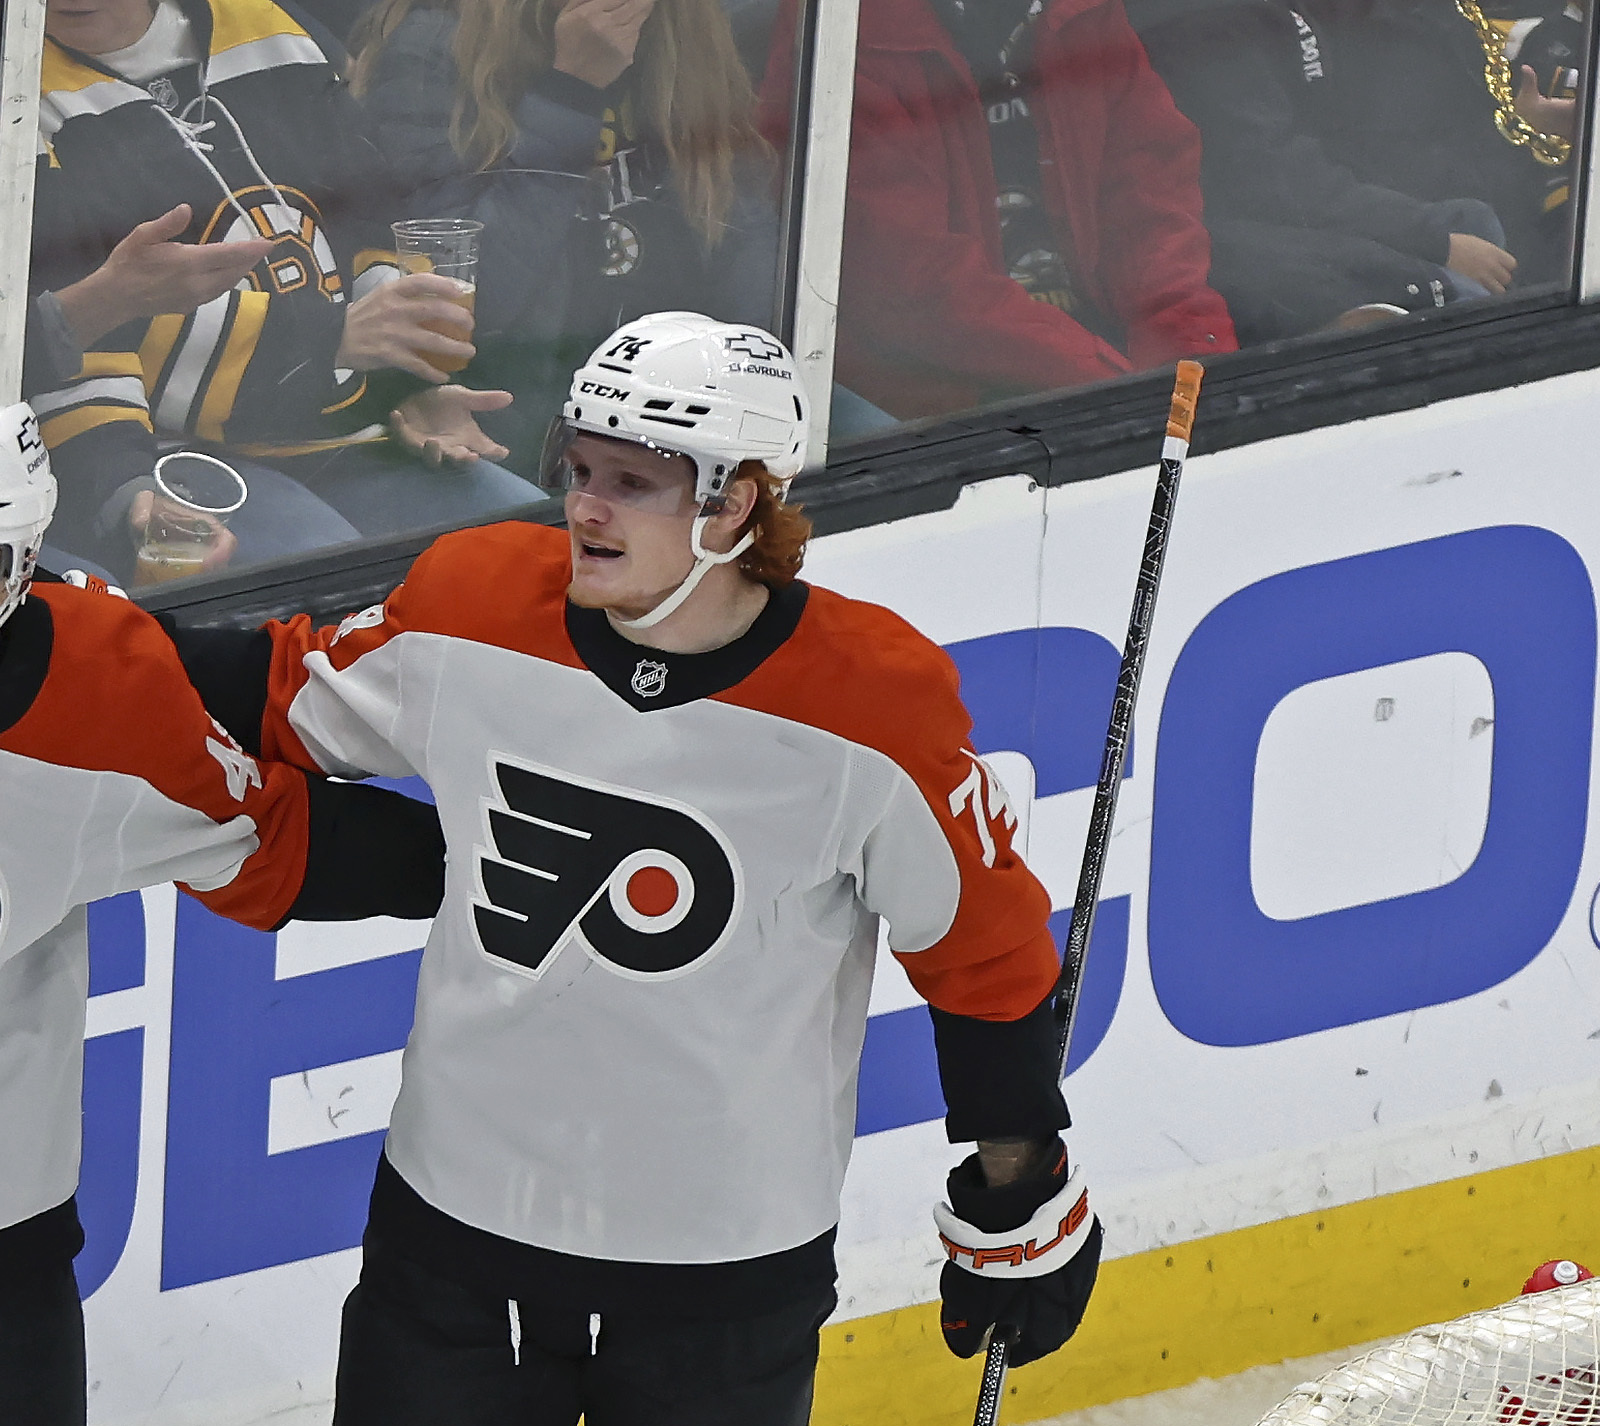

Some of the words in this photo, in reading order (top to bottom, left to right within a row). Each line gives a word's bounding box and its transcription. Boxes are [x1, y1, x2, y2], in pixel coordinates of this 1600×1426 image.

[605, 336, 652, 361] 74
[580, 381, 631, 402] CCM
[72, 524, 1599, 1310] ECO
[939, 1186, 1089, 1269] TRUE
